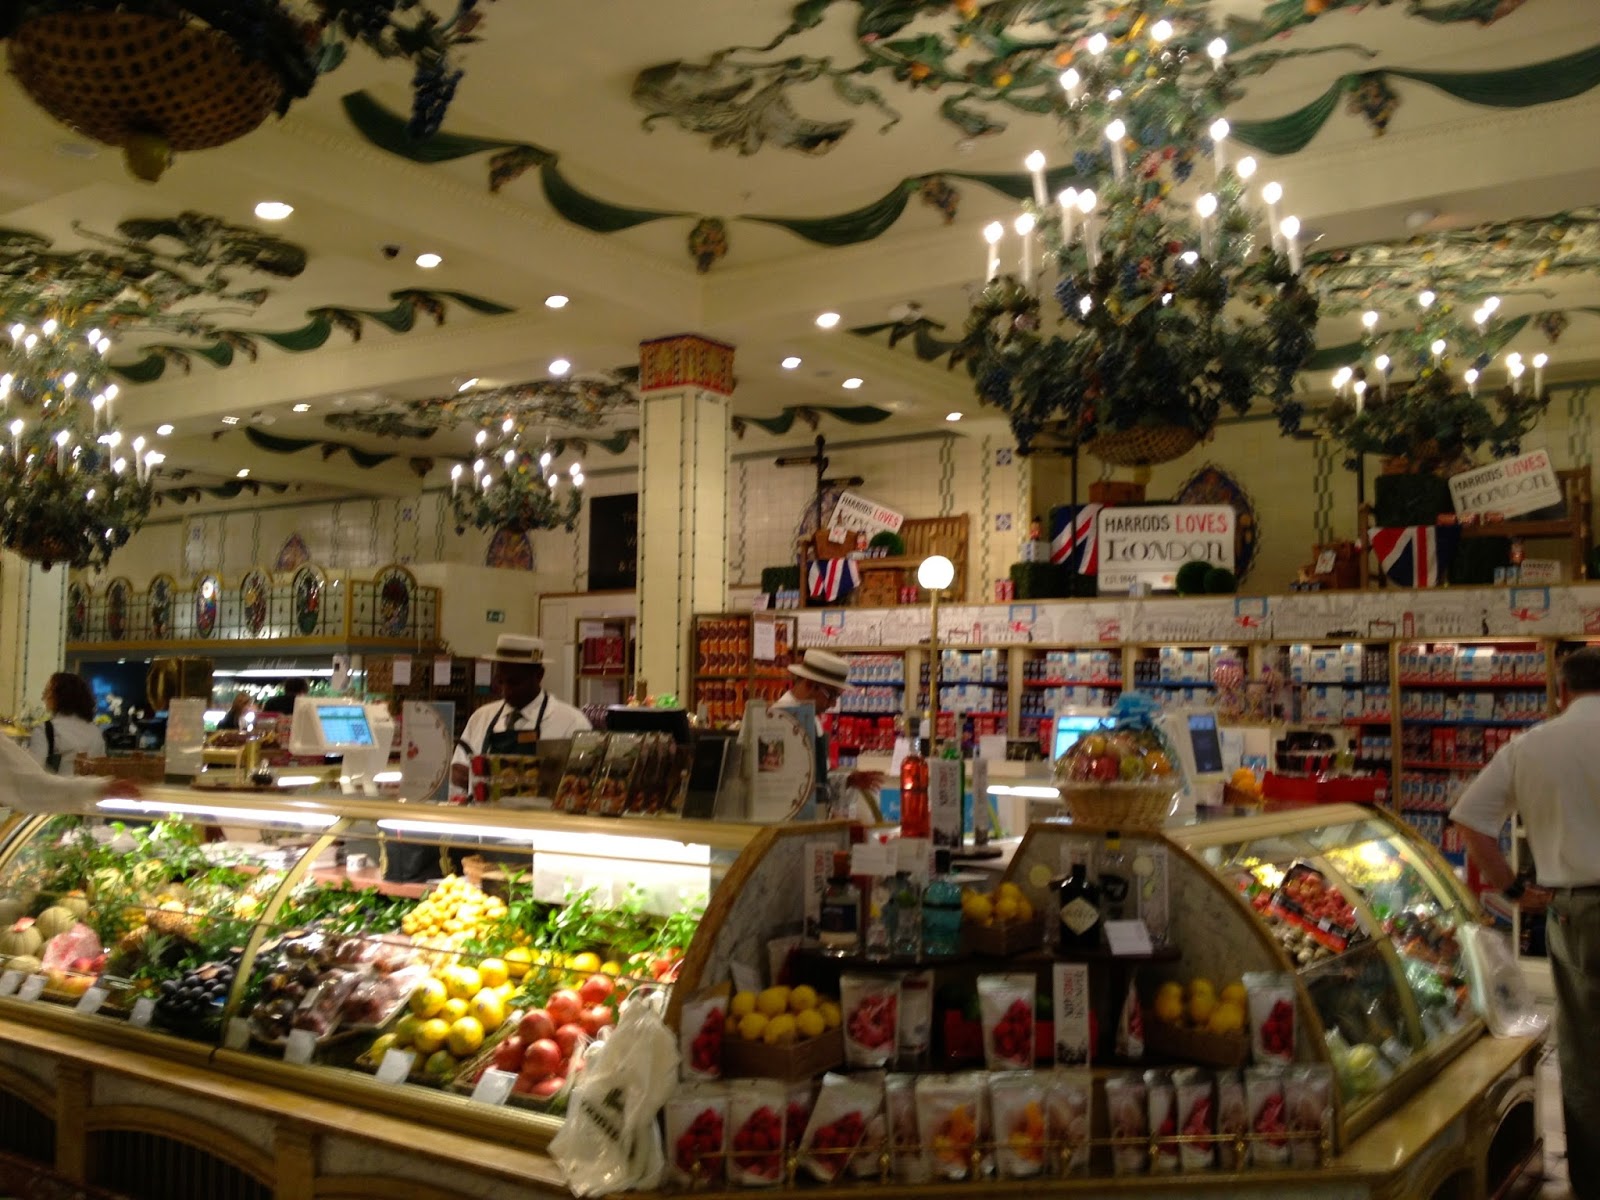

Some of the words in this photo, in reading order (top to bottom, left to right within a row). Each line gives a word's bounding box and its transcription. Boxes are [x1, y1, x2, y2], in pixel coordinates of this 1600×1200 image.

[1453, 468, 1504, 493] HARRODS
[1503, 452, 1547, 478] LOVES
[841, 496, 873, 516] HARRODS
[873, 507, 900, 528] LOVES
[1104, 514, 1170, 533] HARRODS
[1174, 512, 1229, 534] LOVES
